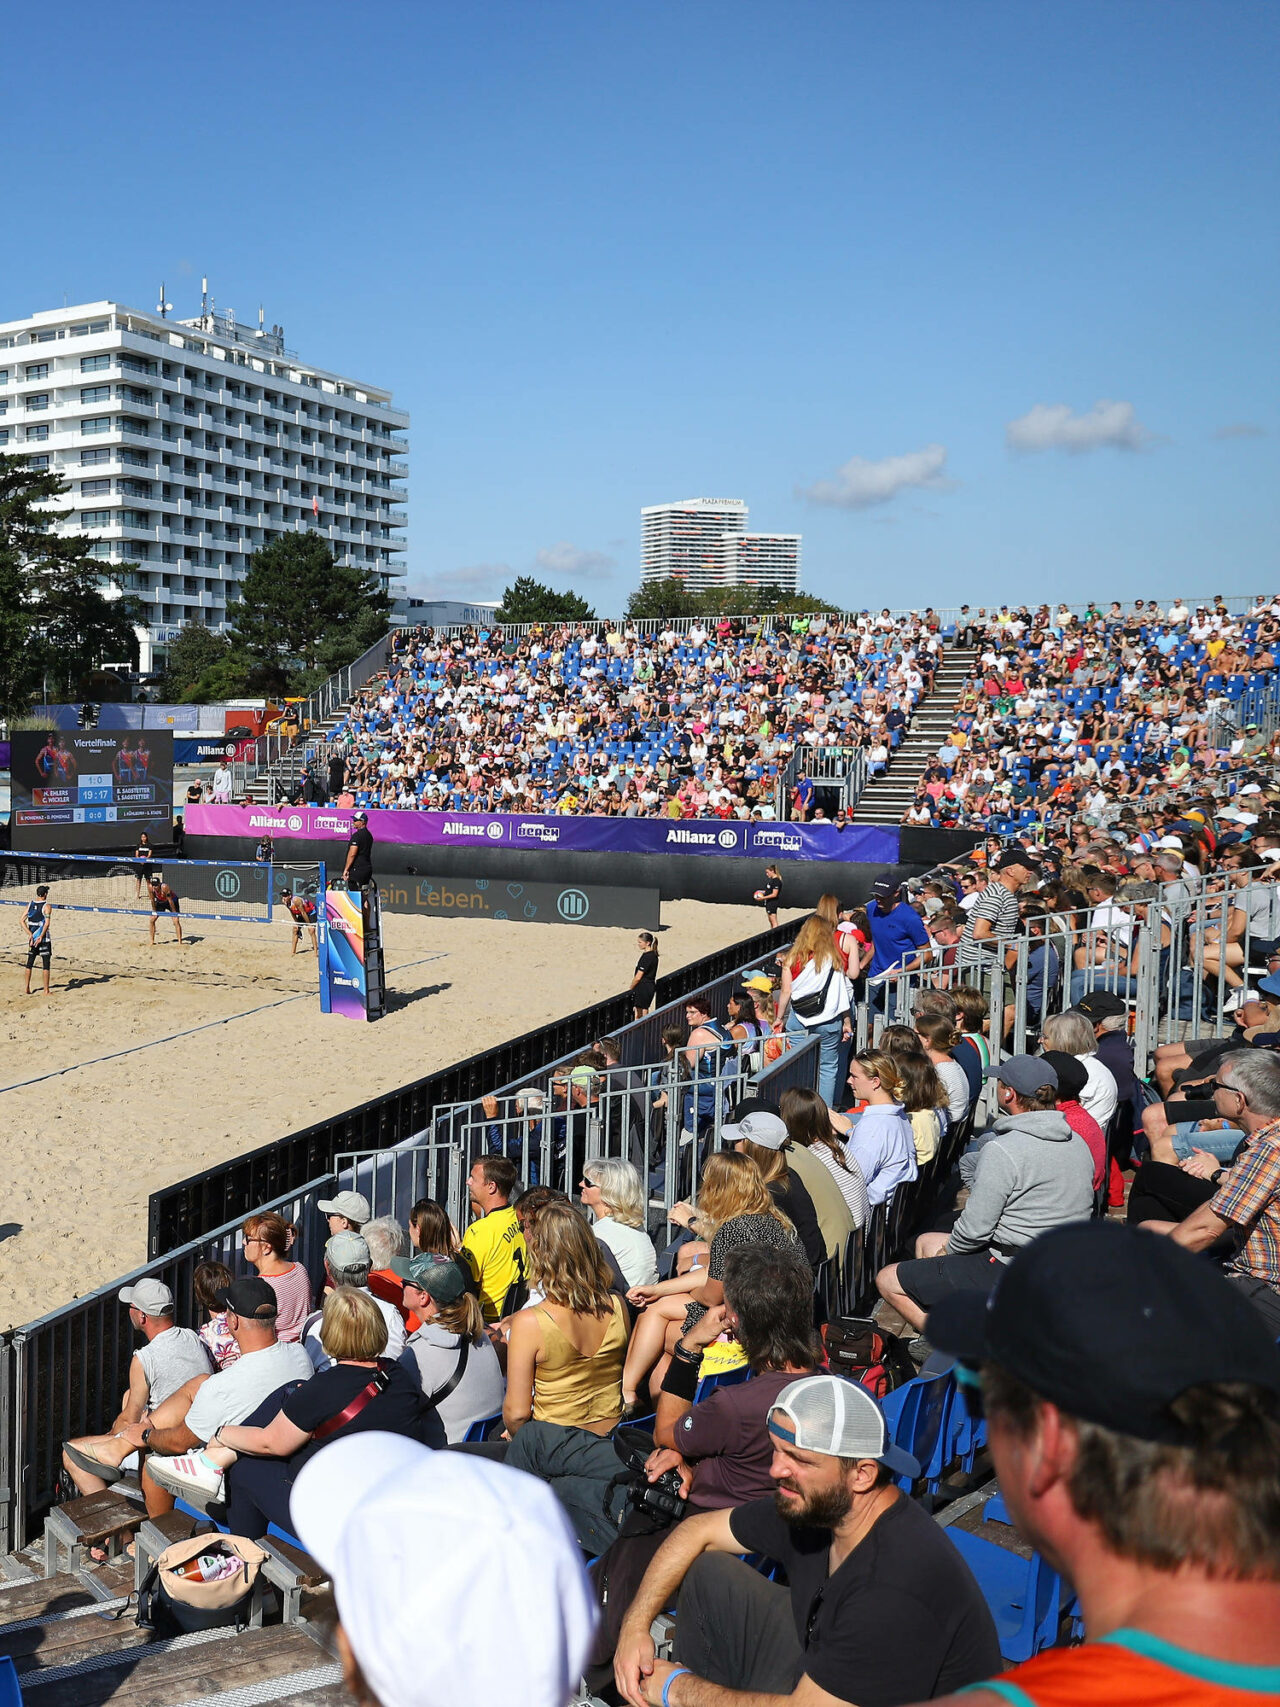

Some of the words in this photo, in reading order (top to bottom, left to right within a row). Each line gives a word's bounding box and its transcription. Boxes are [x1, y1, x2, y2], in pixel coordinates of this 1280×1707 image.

[74, 738, 116, 748] Viertelfinale
[197, 746, 224, 755] Allianz
[249, 816, 286, 828] Allianz
[442, 822, 484, 836] Allianz
[666, 830, 716, 844] Allianz
[416, 886, 489, 909] Leben.
